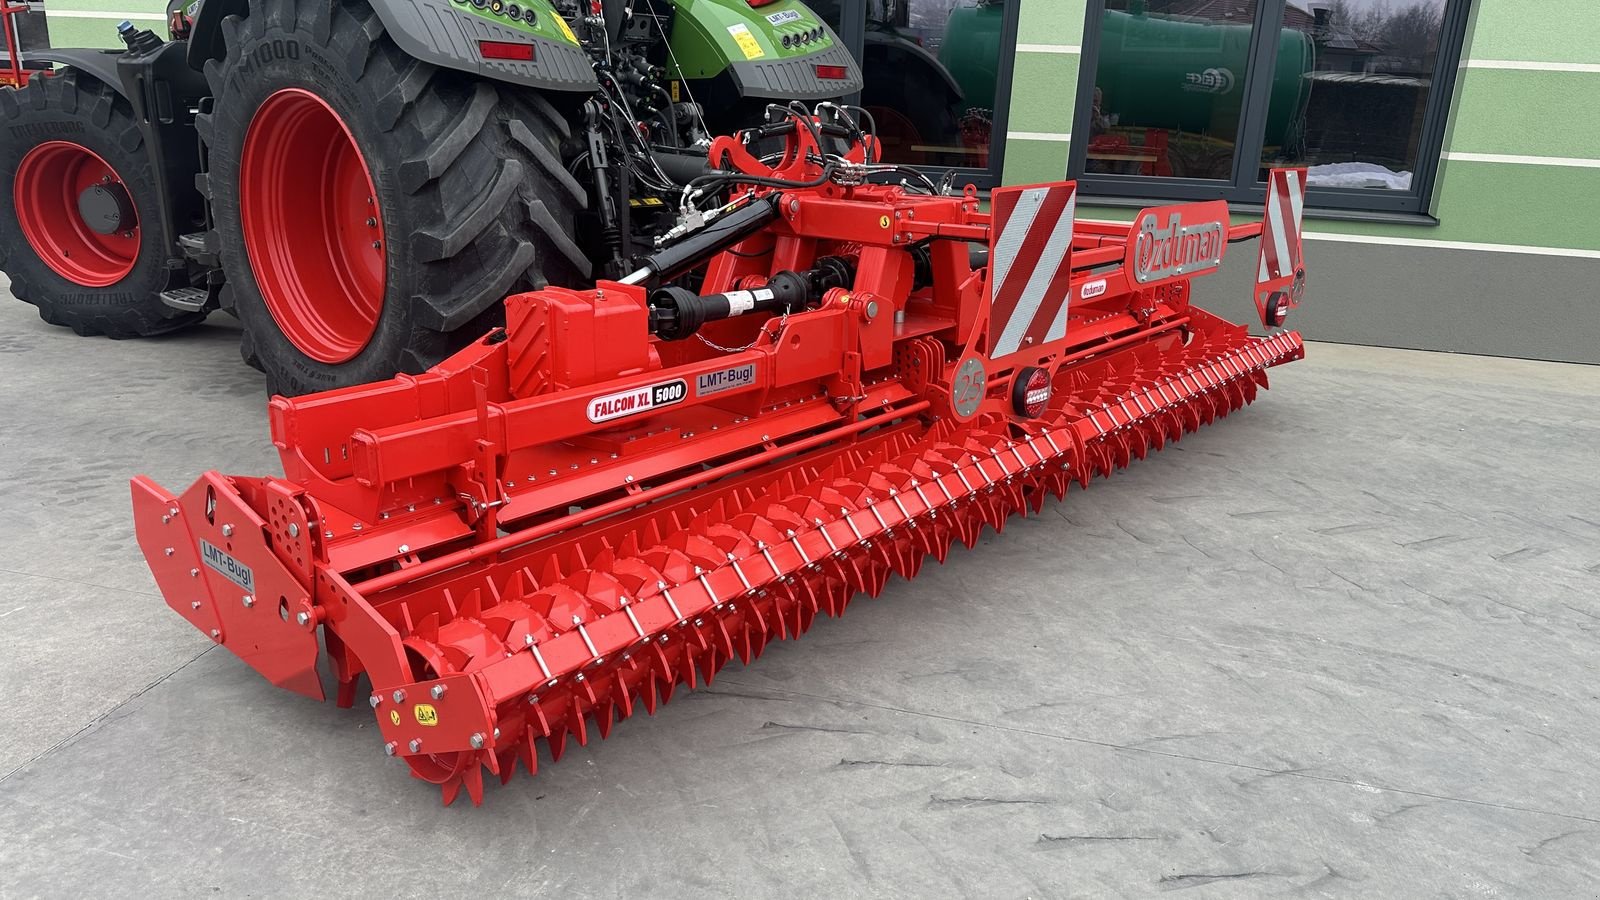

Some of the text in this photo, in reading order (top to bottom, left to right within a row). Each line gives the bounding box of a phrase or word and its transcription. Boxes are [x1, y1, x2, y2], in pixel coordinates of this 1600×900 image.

[1138, 222, 1220, 274] Özduman
[700, 365, 753, 389] LMT-Bugl
[957, 370, 983, 404] 25
[594, 395, 635, 418] FALCON
[637, 392, 650, 406] XL
[655, 384, 682, 403] 5000
[202, 541, 251, 585] LMT-Bugl
